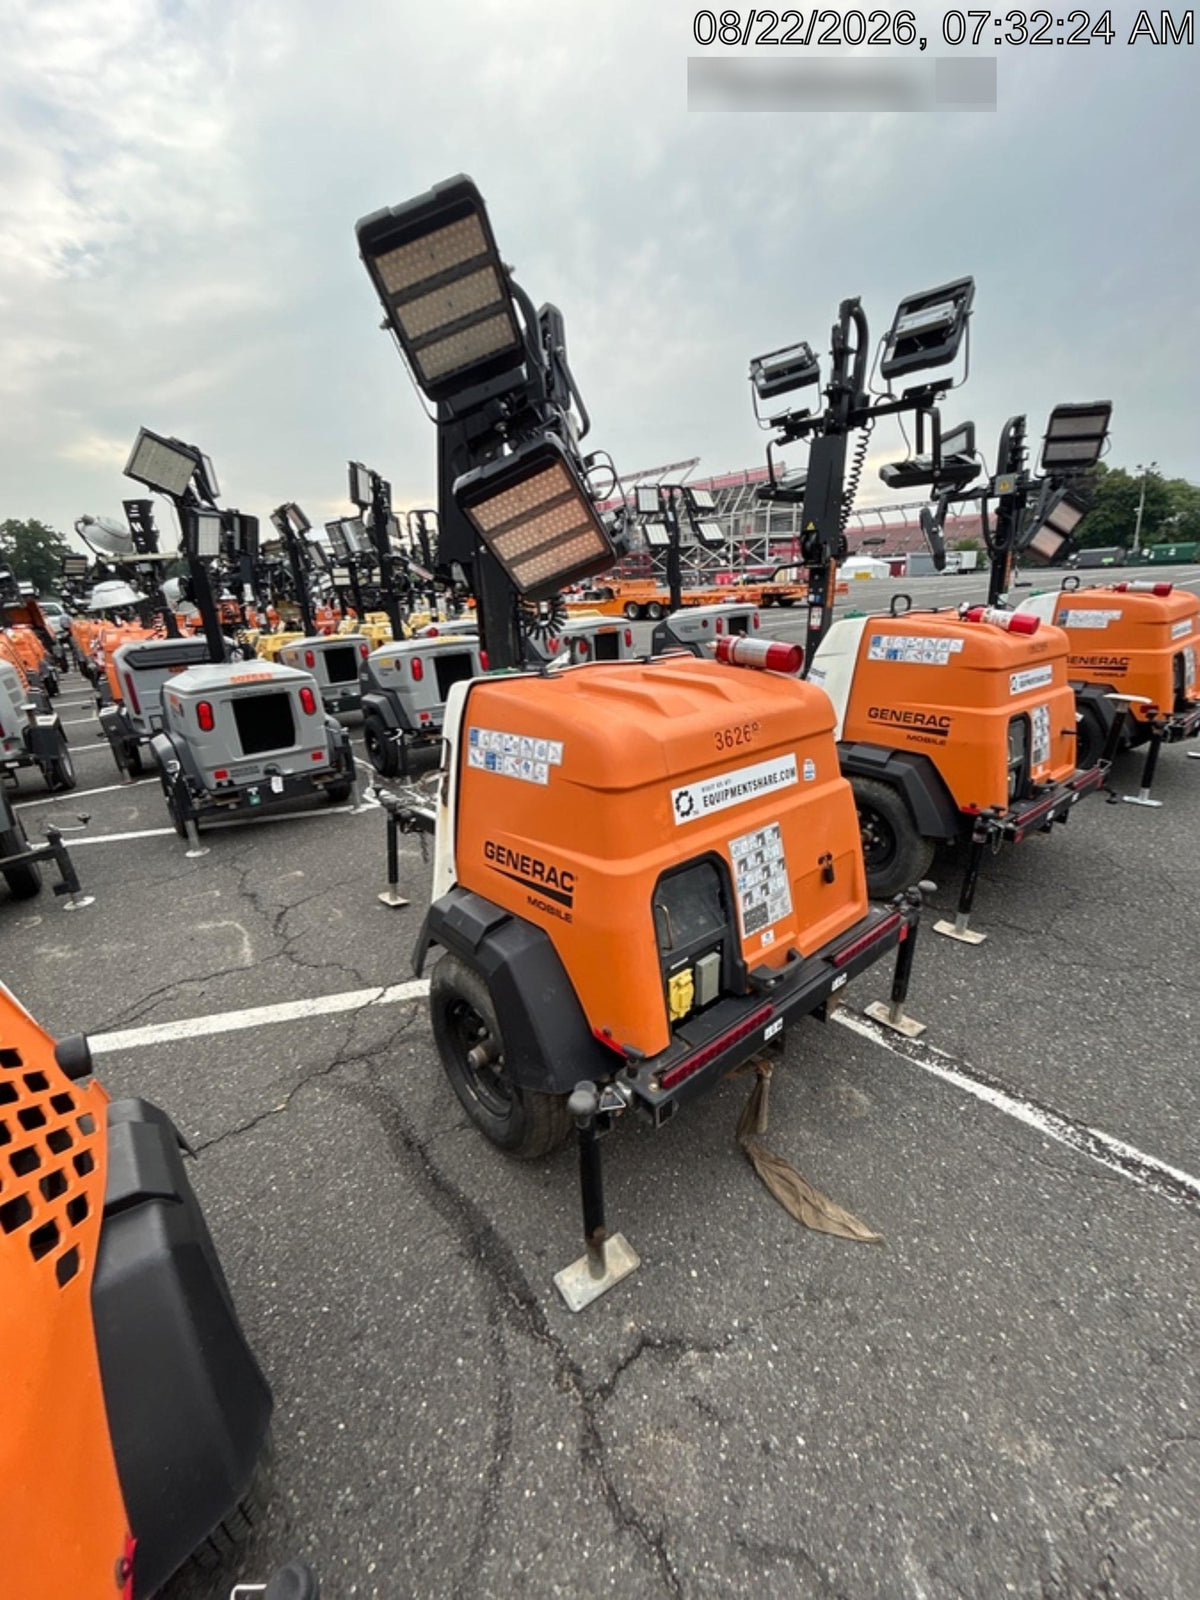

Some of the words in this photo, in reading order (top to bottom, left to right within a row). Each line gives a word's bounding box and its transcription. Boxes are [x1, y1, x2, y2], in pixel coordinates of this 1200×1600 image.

[868, 707, 951, 728] GENERAC
[703, 766, 796, 808] EQUIPMENTSHARE.COM
[484, 840, 575, 893] GENERAC
[527, 895, 573, 923] MOBILE
